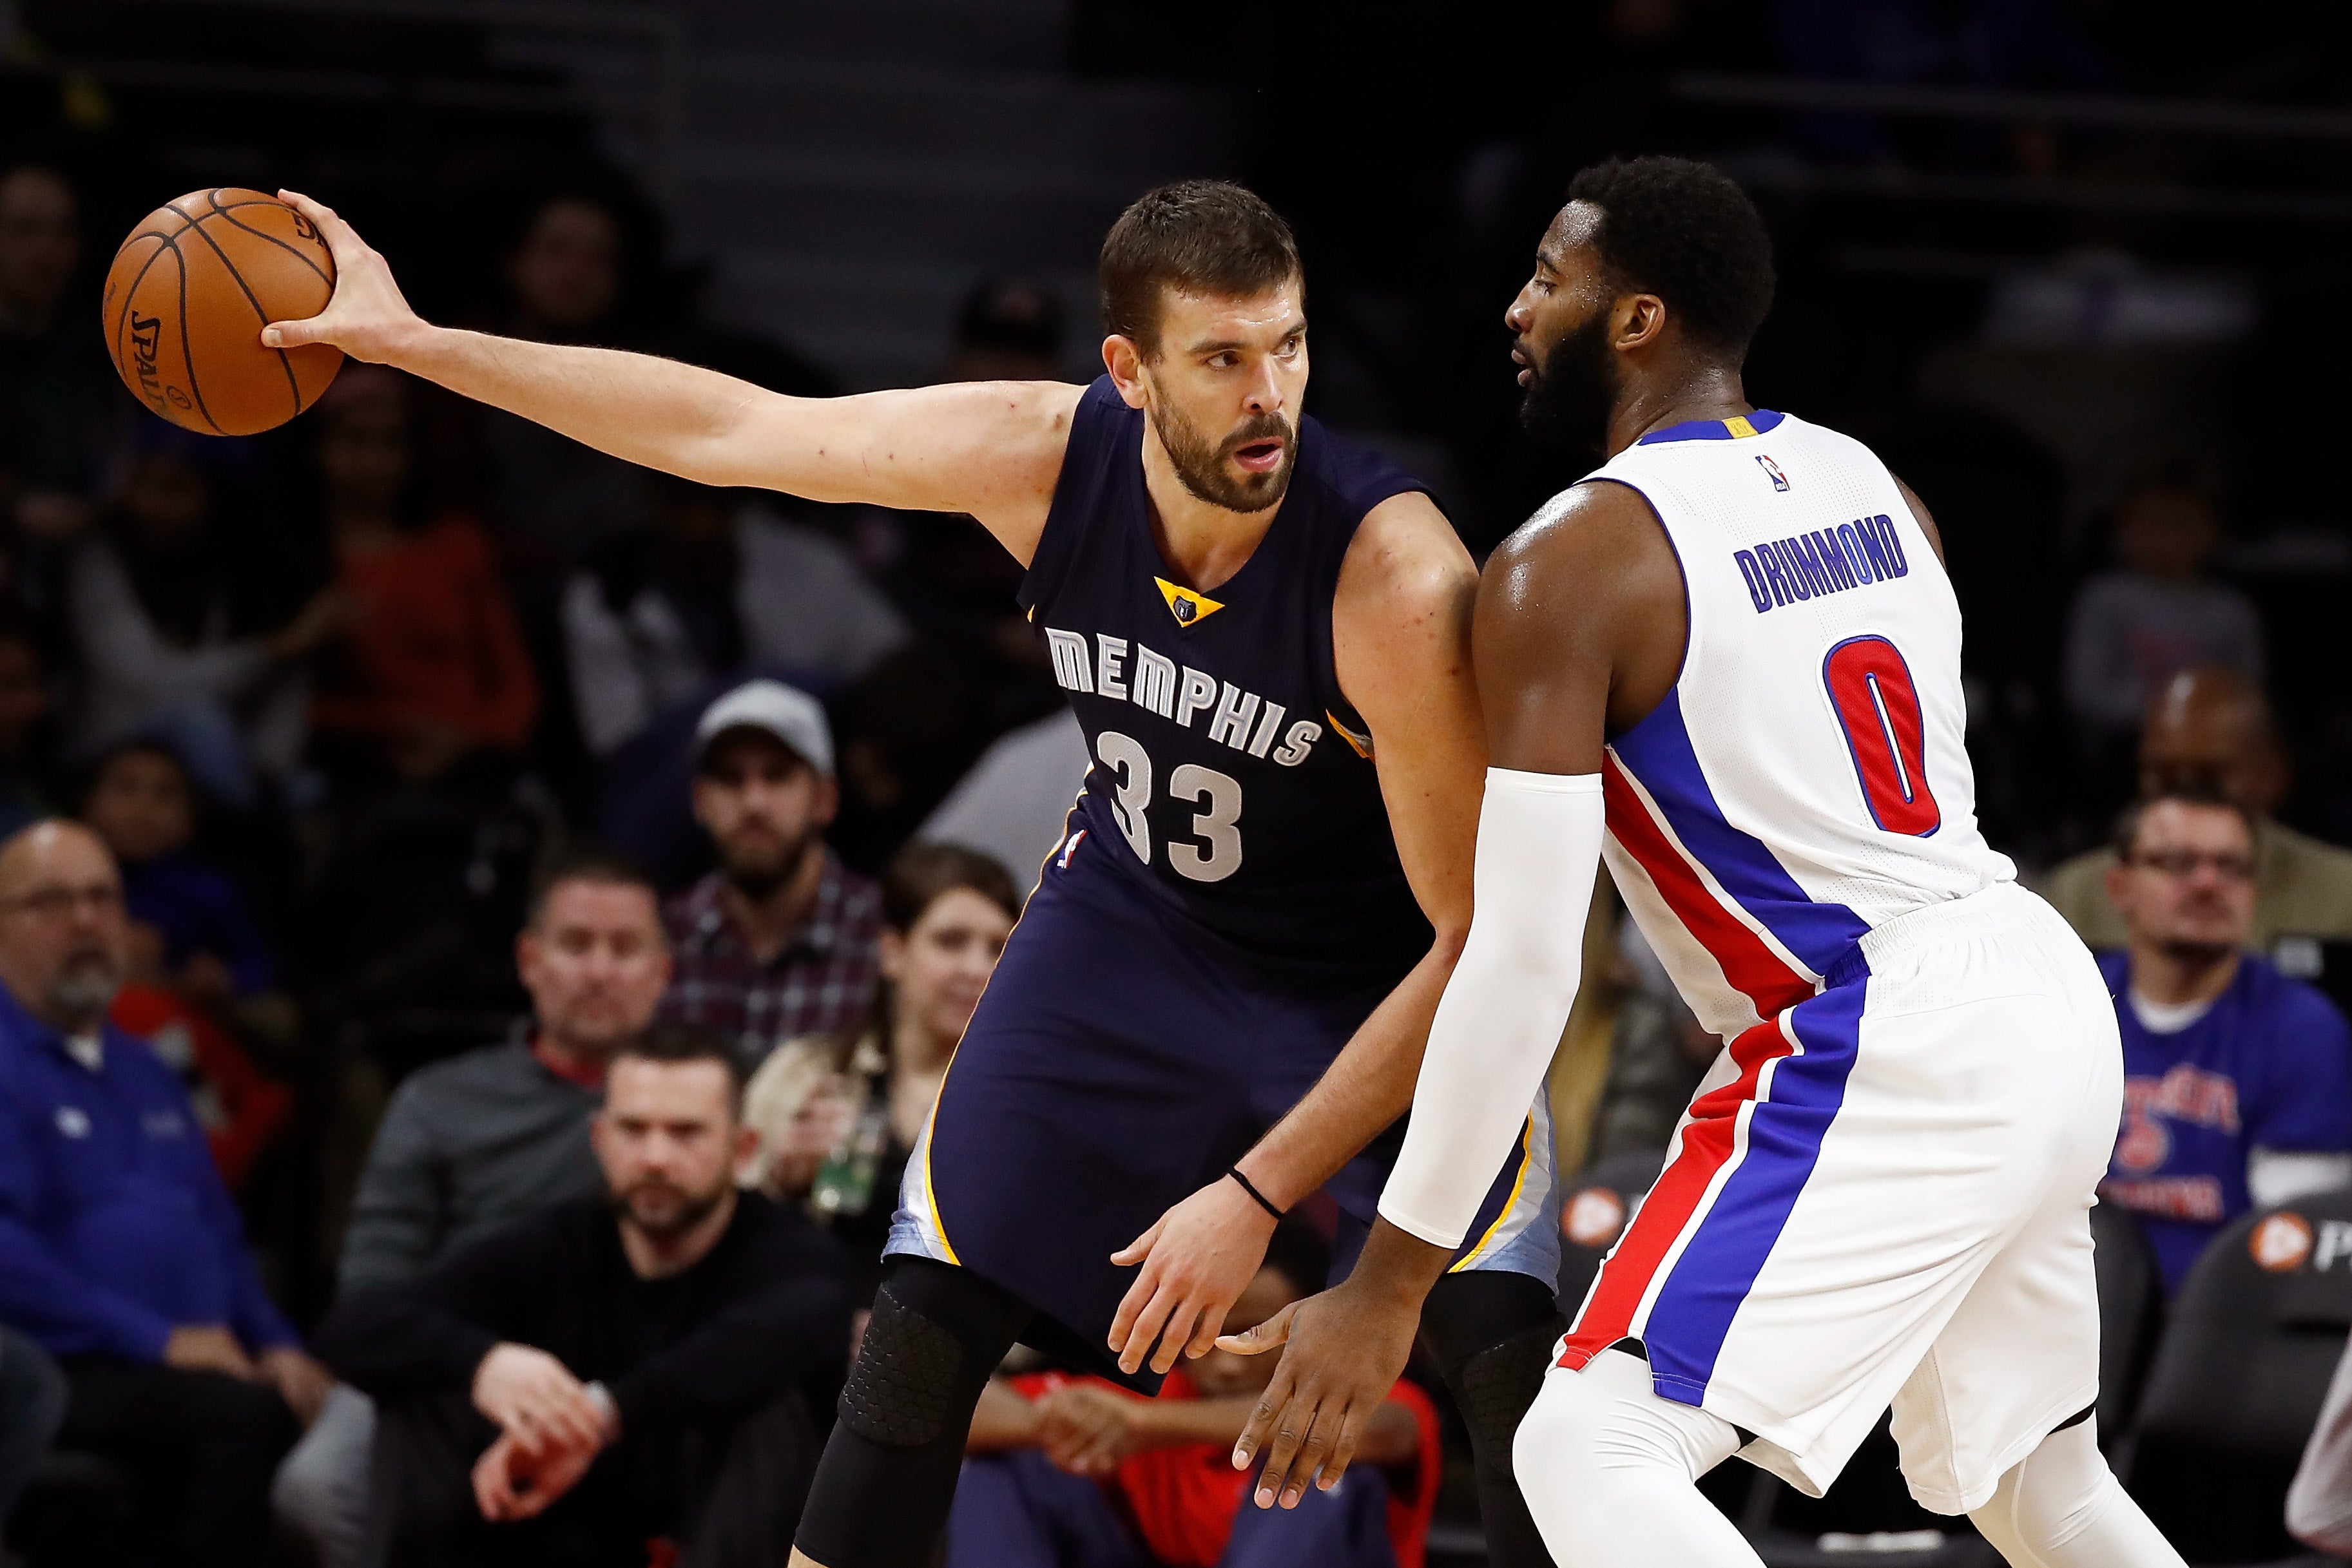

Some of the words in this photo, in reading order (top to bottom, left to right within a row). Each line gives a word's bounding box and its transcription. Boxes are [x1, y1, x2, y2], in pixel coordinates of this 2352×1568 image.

[1733, 514, 1909, 614] DRUMMOND
[1045, 627, 1323, 766] MEMPHIS
[1822, 634, 1941, 838] 0
[1097, 731, 1242, 882] 33
